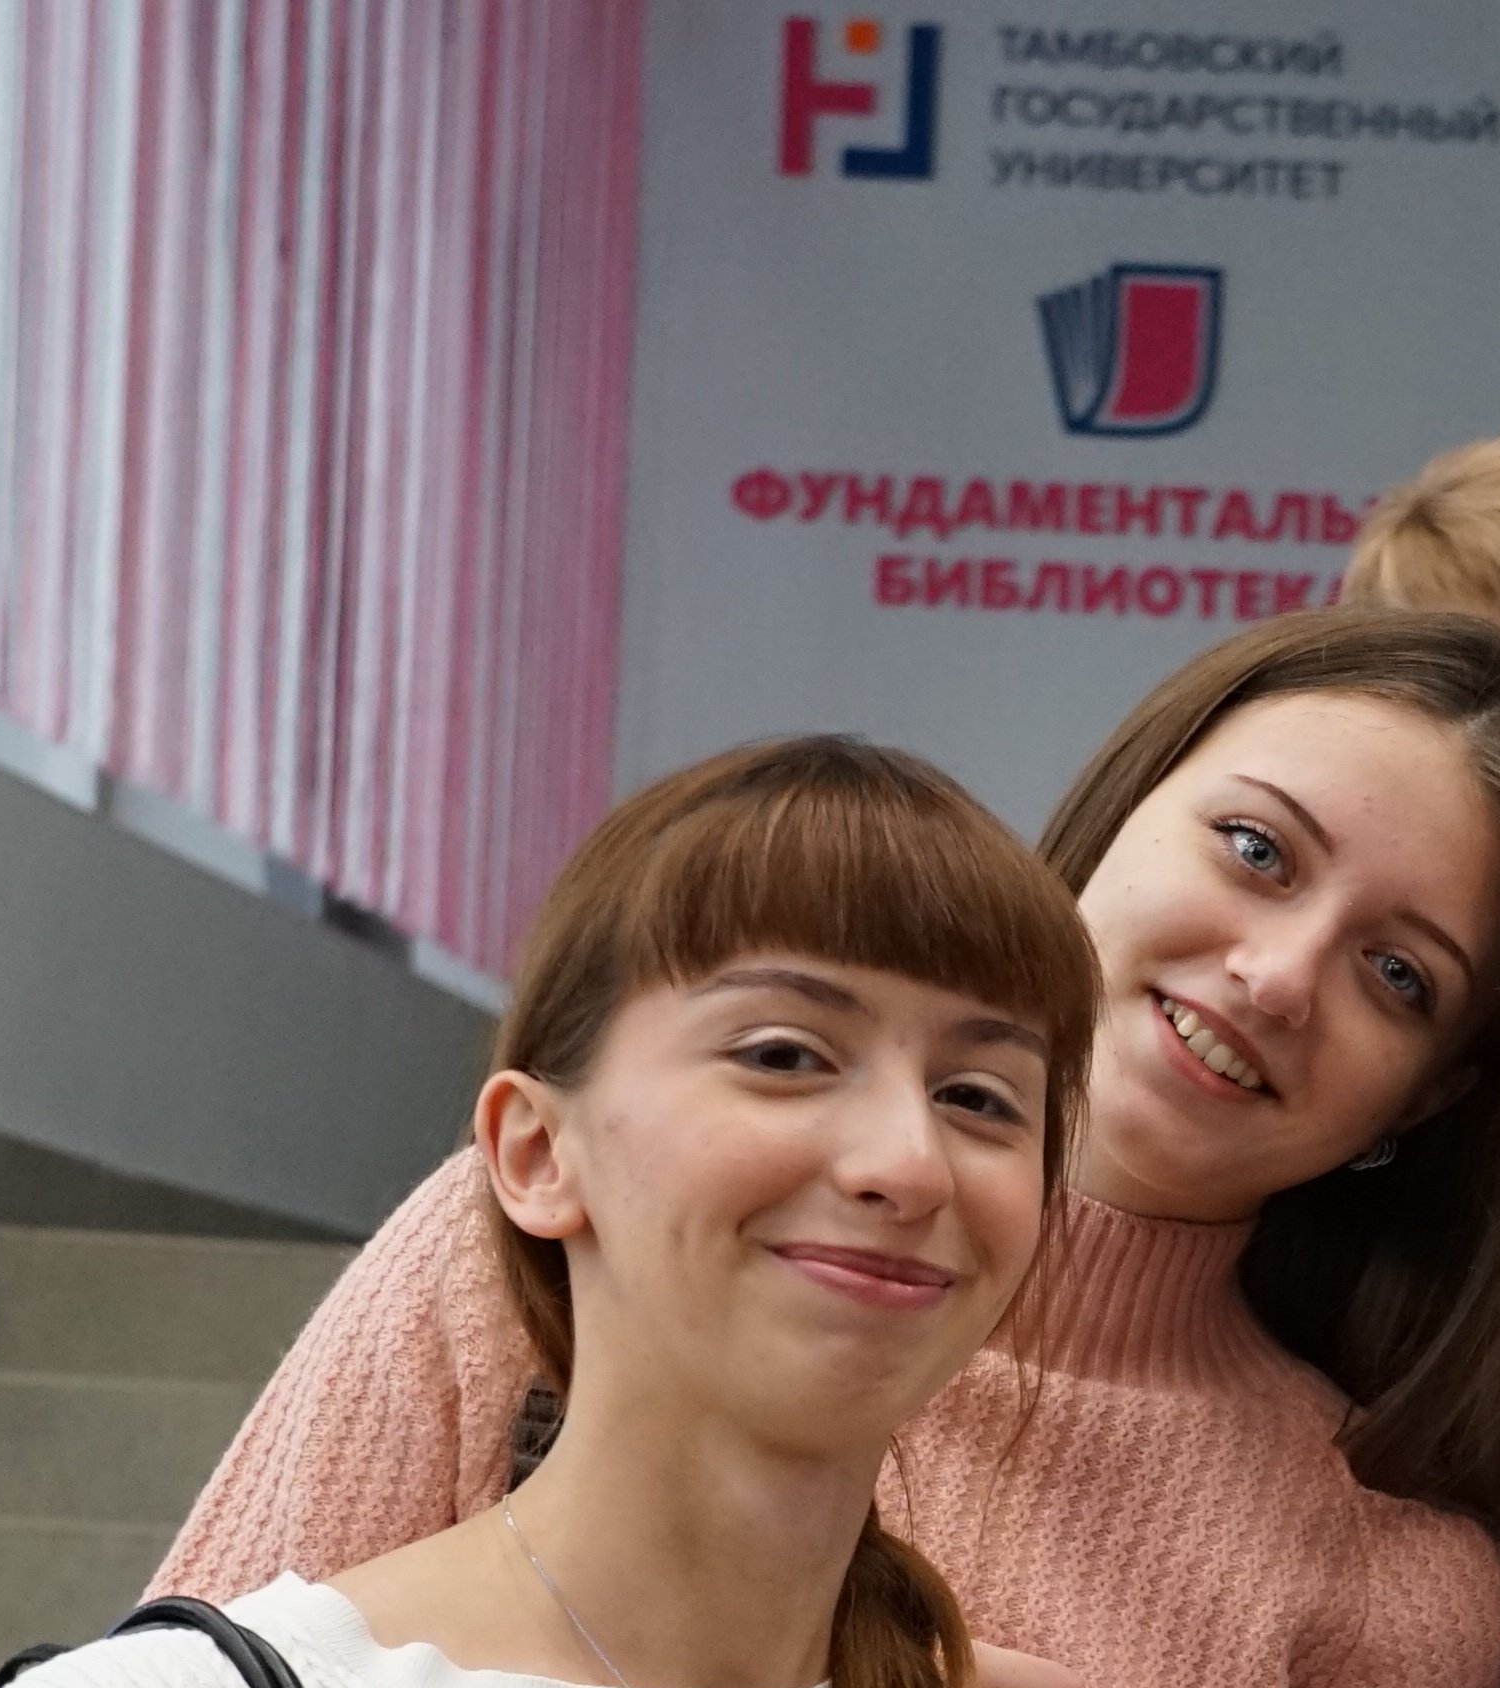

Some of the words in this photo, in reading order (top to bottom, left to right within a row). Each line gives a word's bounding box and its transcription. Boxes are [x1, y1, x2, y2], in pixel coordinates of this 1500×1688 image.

[998, 25, 1344, 77] ТАМБОВСКИЙ
[991, 149, 1346, 198] УНИВЕРСИТЕТ
[731, 468, 1380, 545] ФУНДАМЕНТАЛЬ
